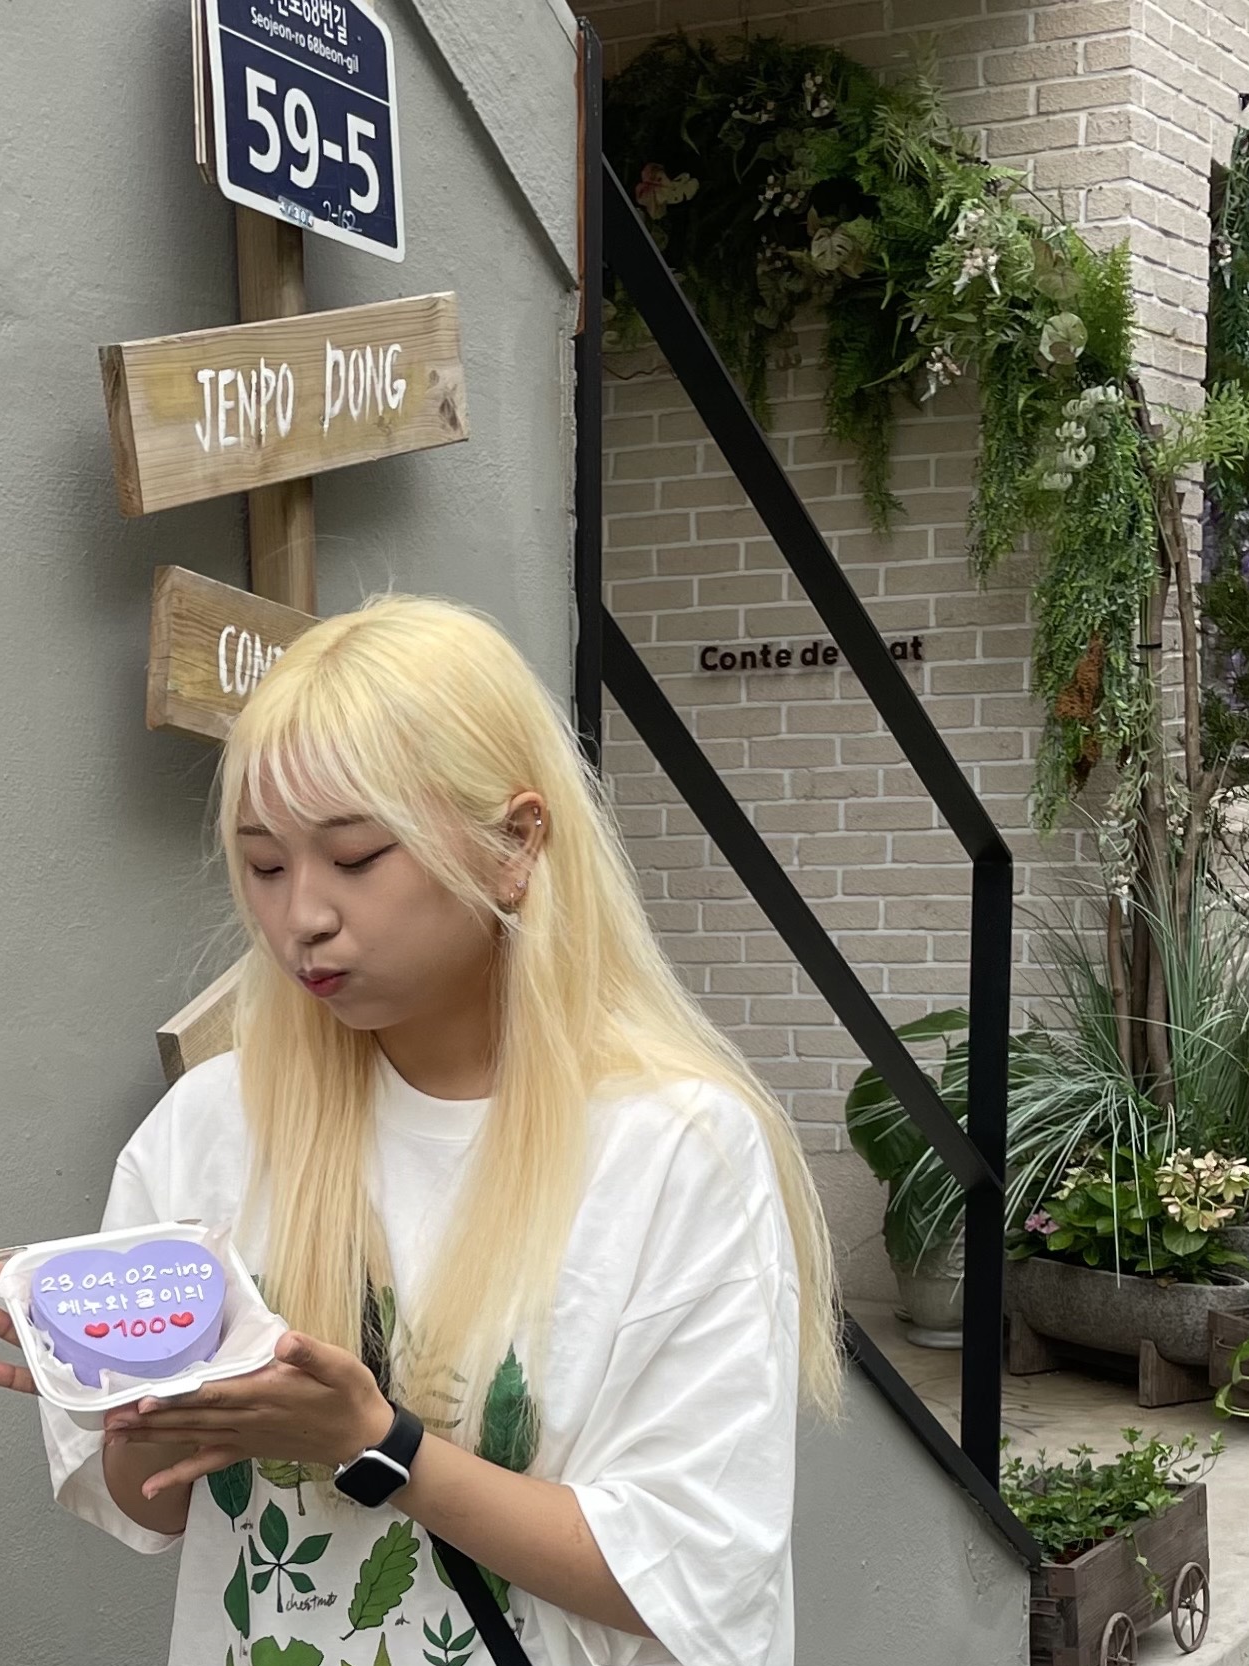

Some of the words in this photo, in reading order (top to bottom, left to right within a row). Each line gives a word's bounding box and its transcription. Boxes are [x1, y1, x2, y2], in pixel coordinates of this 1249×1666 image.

[251, 6, 306, 48] Seojeon-ro
[307, 33, 360, 74] 68beon-gil
[245, 66, 380, 214] 59-5
[194, 356, 295, 452] JENPO
[321, 337, 408, 440] DONG
[700, 643, 792, 671] Conte
[800, 641, 839, 667] de
[112, 1316, 167, 1338] 100
